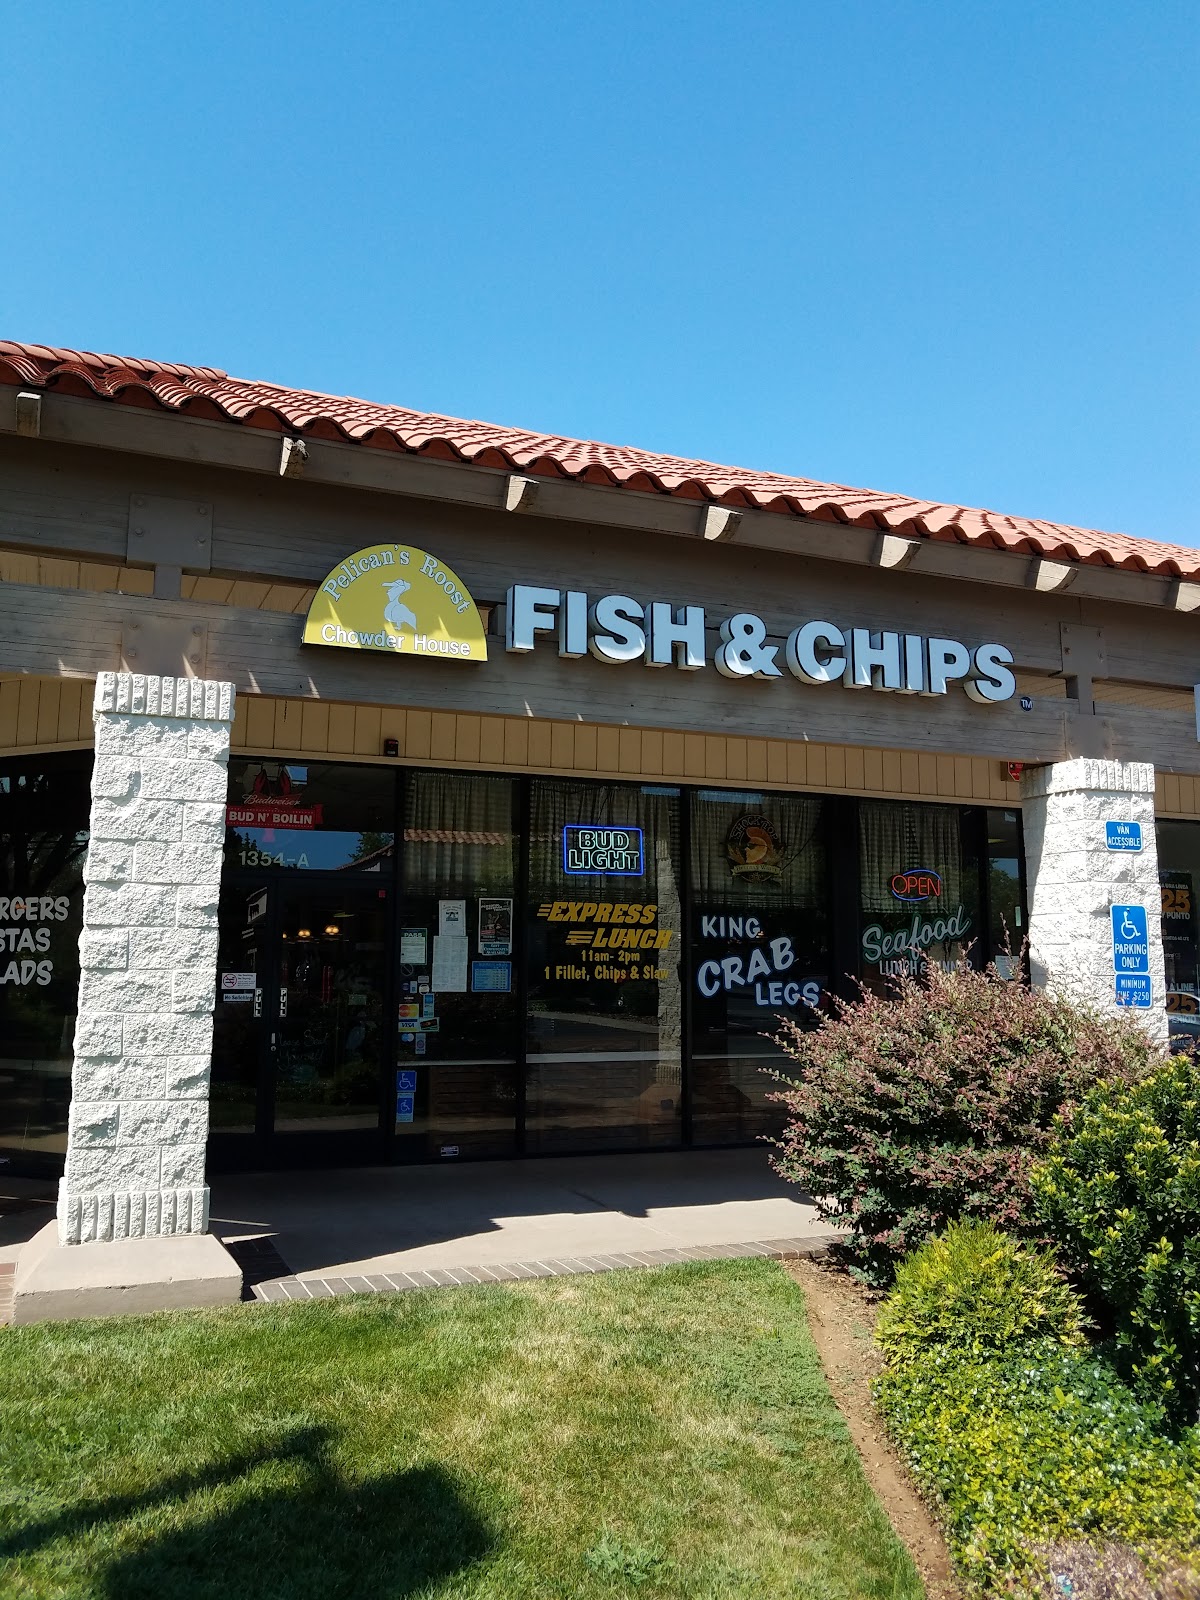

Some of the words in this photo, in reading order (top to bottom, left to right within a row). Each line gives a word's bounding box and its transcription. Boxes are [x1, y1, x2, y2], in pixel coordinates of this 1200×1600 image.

[323, 544, 410, 601] Pelican's
[420, 553, 472, 614] Roost
[321, 624, 405, 649] Chowder
[414, 634, 471, 656] House
[508, 584, 706, 670] FISH
[716, 613, 784, 679] &
[787, 620, 1017, 702] CHIPS
[1020, 698, 1034, 710] TM
[241, 793, 302, 806] Budweiser
[229, 811, 254, 822] BUD
[273, 813, 312, 825] BOILIN
[1116, 825, 1130, 835] VAN
[579, 830, 629, 850] BUD
[1108, 837, 1141, 847] ACCESSIBLE
[239, 850, 310, 867] 1354-A
[568, 850, 640, 869] LIGHT
[891, 875, 941, 897] OPEN
[547, 902, 659, 924] EXPRESS
[1166, 912, 1191, 920] PUNTO
[702, 916, 761, 938] KING
[862, 905, 970, 961] Seafood
[592, 928, 673, 949] LUNCH
[617, 950, 641, 965] 2pm
[1114, 943, 1147, 955] PARKING
[698, 937, 795, 997] CRAB
[1121, 957, 1141, 968] ONLY
[544, 966, 550, 980] 1
[556, 965, 590, 981] Fillet,
[594, 965, 627, 983] Chips
[630, 966, 640, 980] &
[643, 965, 669, 980] Slaw
[1120, 979, 1146, 989] MINIMUM
[1177, 983, 1195, 992] LINE
[255, 989, 263, 1016] PULL
[279, 989, 287, 1016] PULL
[755, 982, 820, 1007] LEGS
